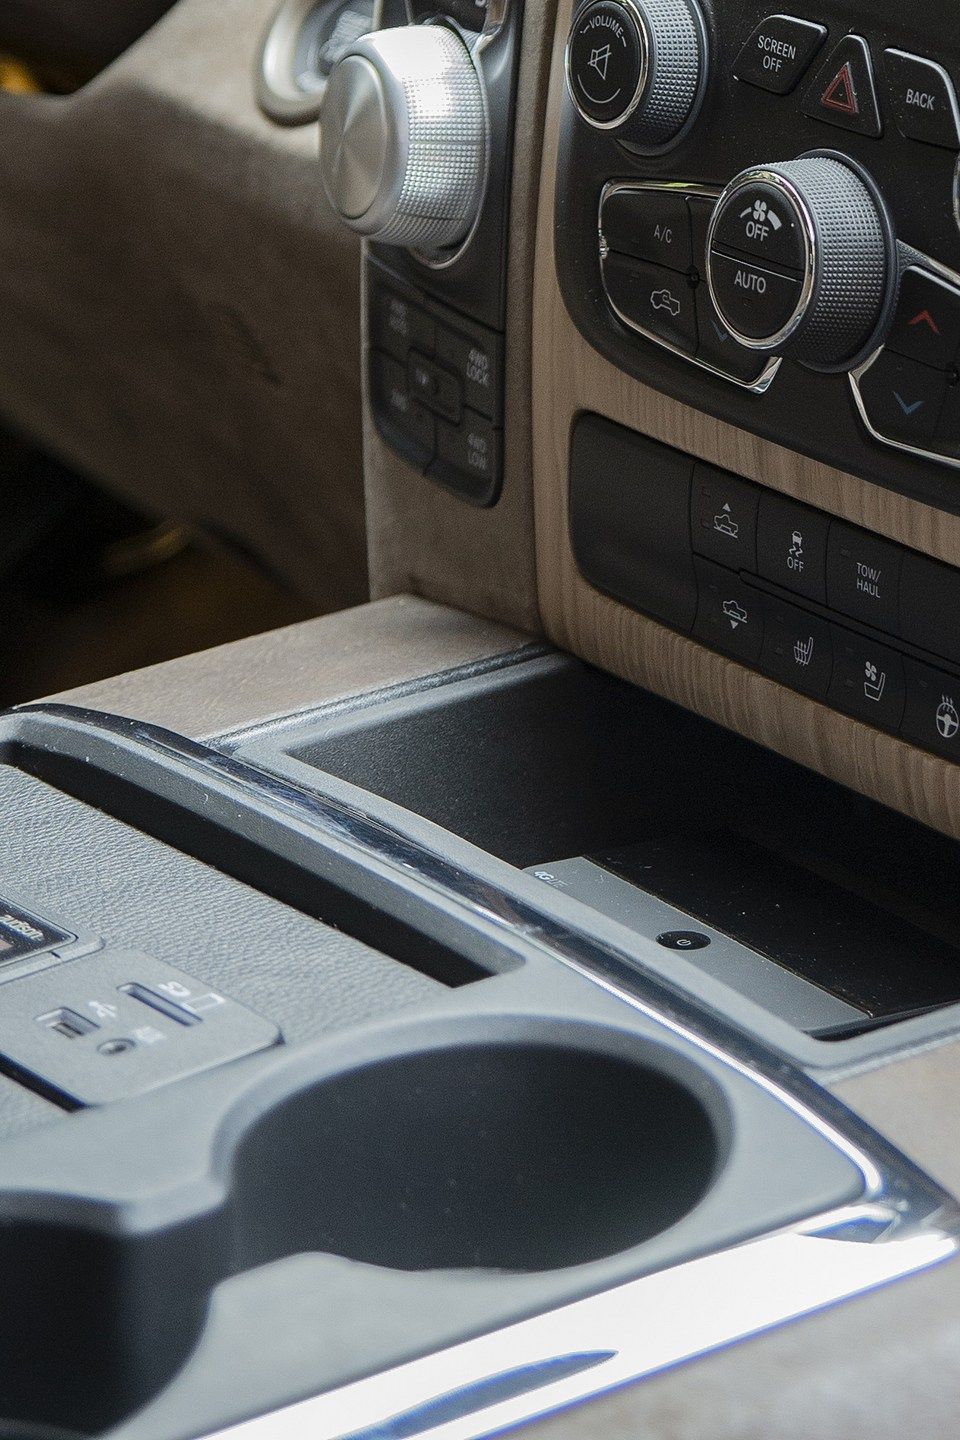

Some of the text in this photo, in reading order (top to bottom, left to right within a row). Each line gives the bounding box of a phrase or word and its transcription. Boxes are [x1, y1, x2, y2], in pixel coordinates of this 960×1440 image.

[589, 15, 624, 39] VOLUME
[757, 35, 796, 60] SCREEN
[763, 55, 782, 72] OFF
[906, 88, 935, 111] BACK
[653, 224, 672, 244] A/C
[745, 221, 769, 242] OFF
[733, 270, 767, 294] AUTO
[787, 556, 804, 573] OFF
[856, 562, 882, 583] TOW/
[856, 578, 881, 599] HAUL
